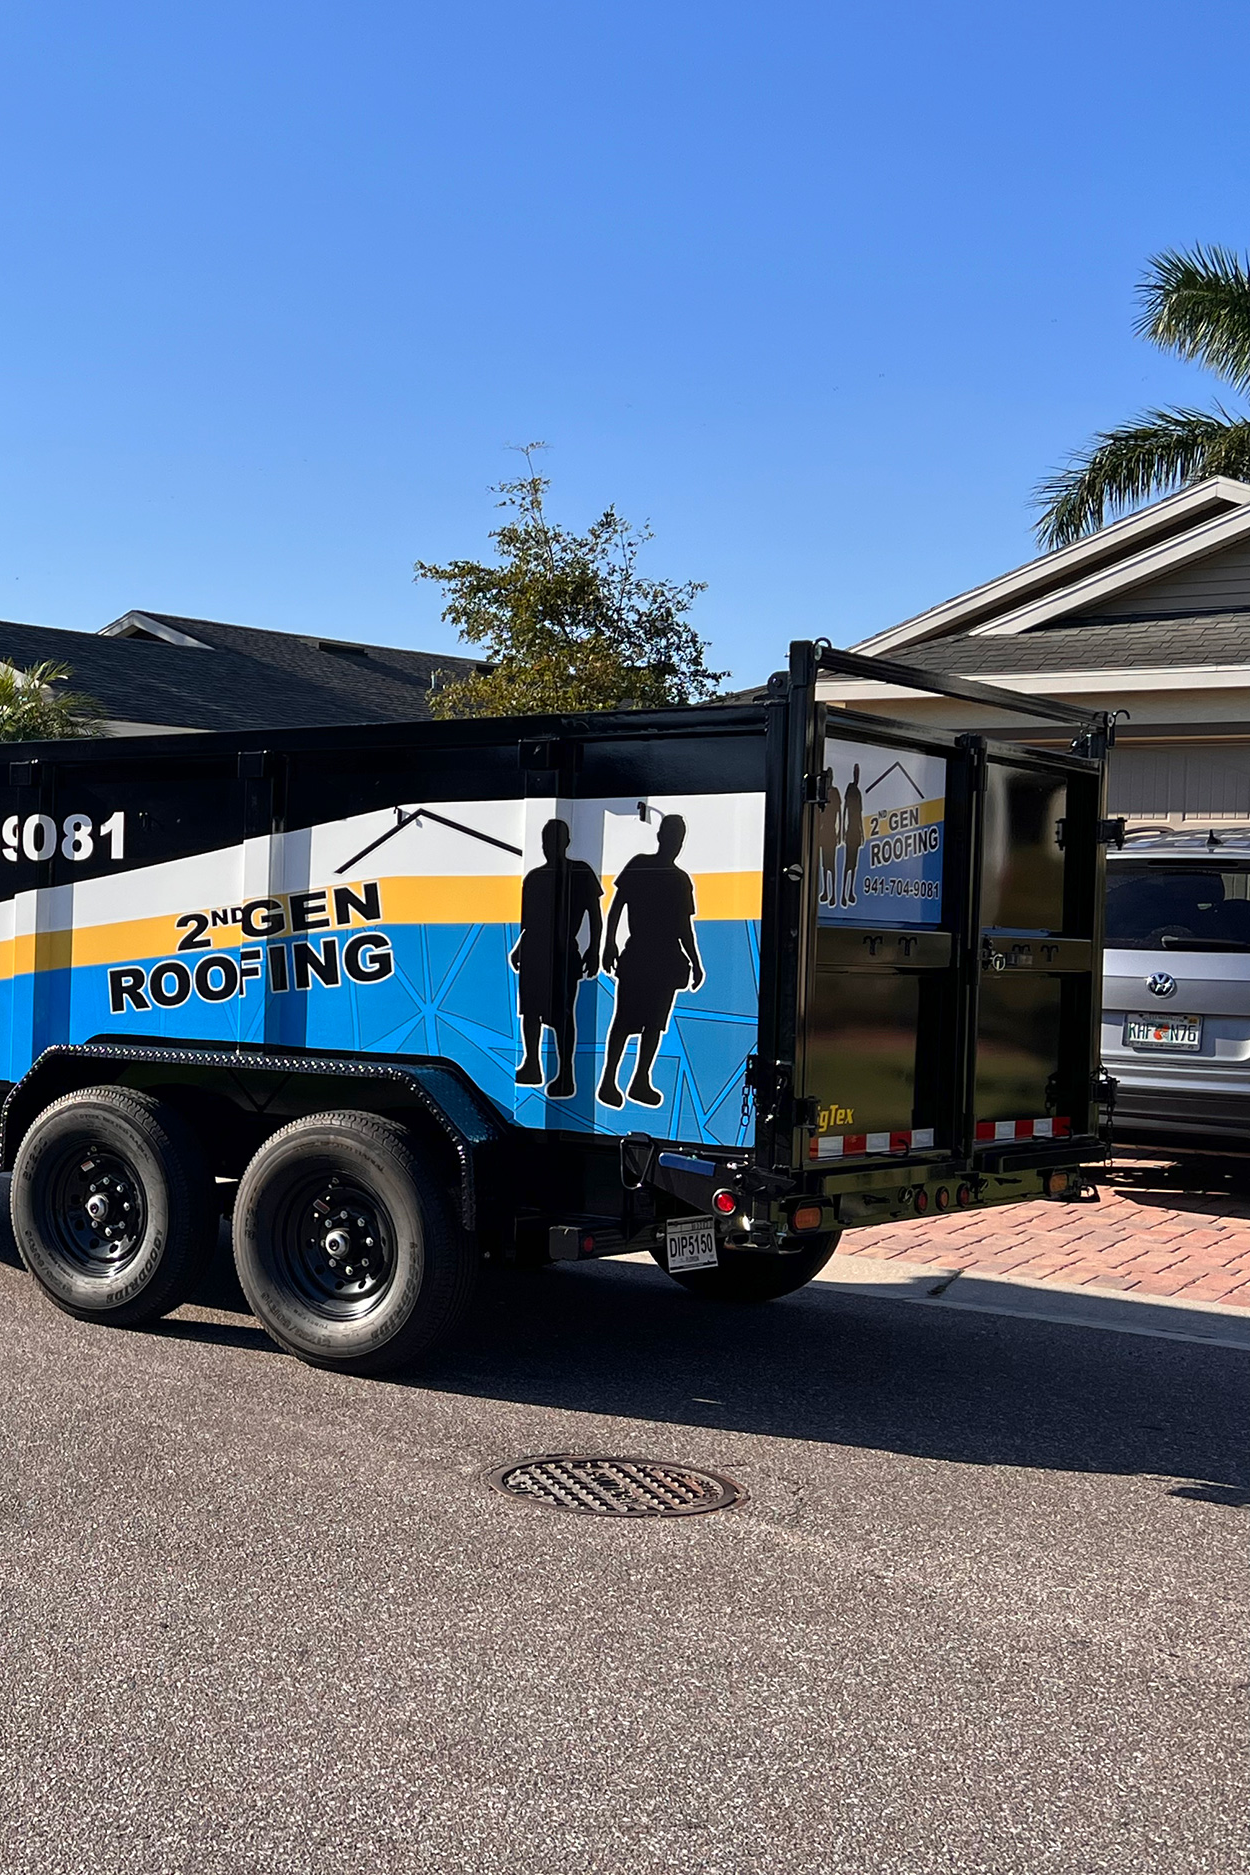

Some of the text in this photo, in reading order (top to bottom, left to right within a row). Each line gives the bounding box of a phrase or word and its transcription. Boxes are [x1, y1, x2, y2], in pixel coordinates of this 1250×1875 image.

[888, 806, 920, 833] GEN
[870, 826, 939, 868] ROOFING
[863, 876, 939, 899] 941-704-9081
[241, 881, 383, 938] GEN
[108, 932, 394, 1015] ROOFING
[817, 1104, 855, 1133] gTex
[669, 1232, 713, 1258] DIP5150
